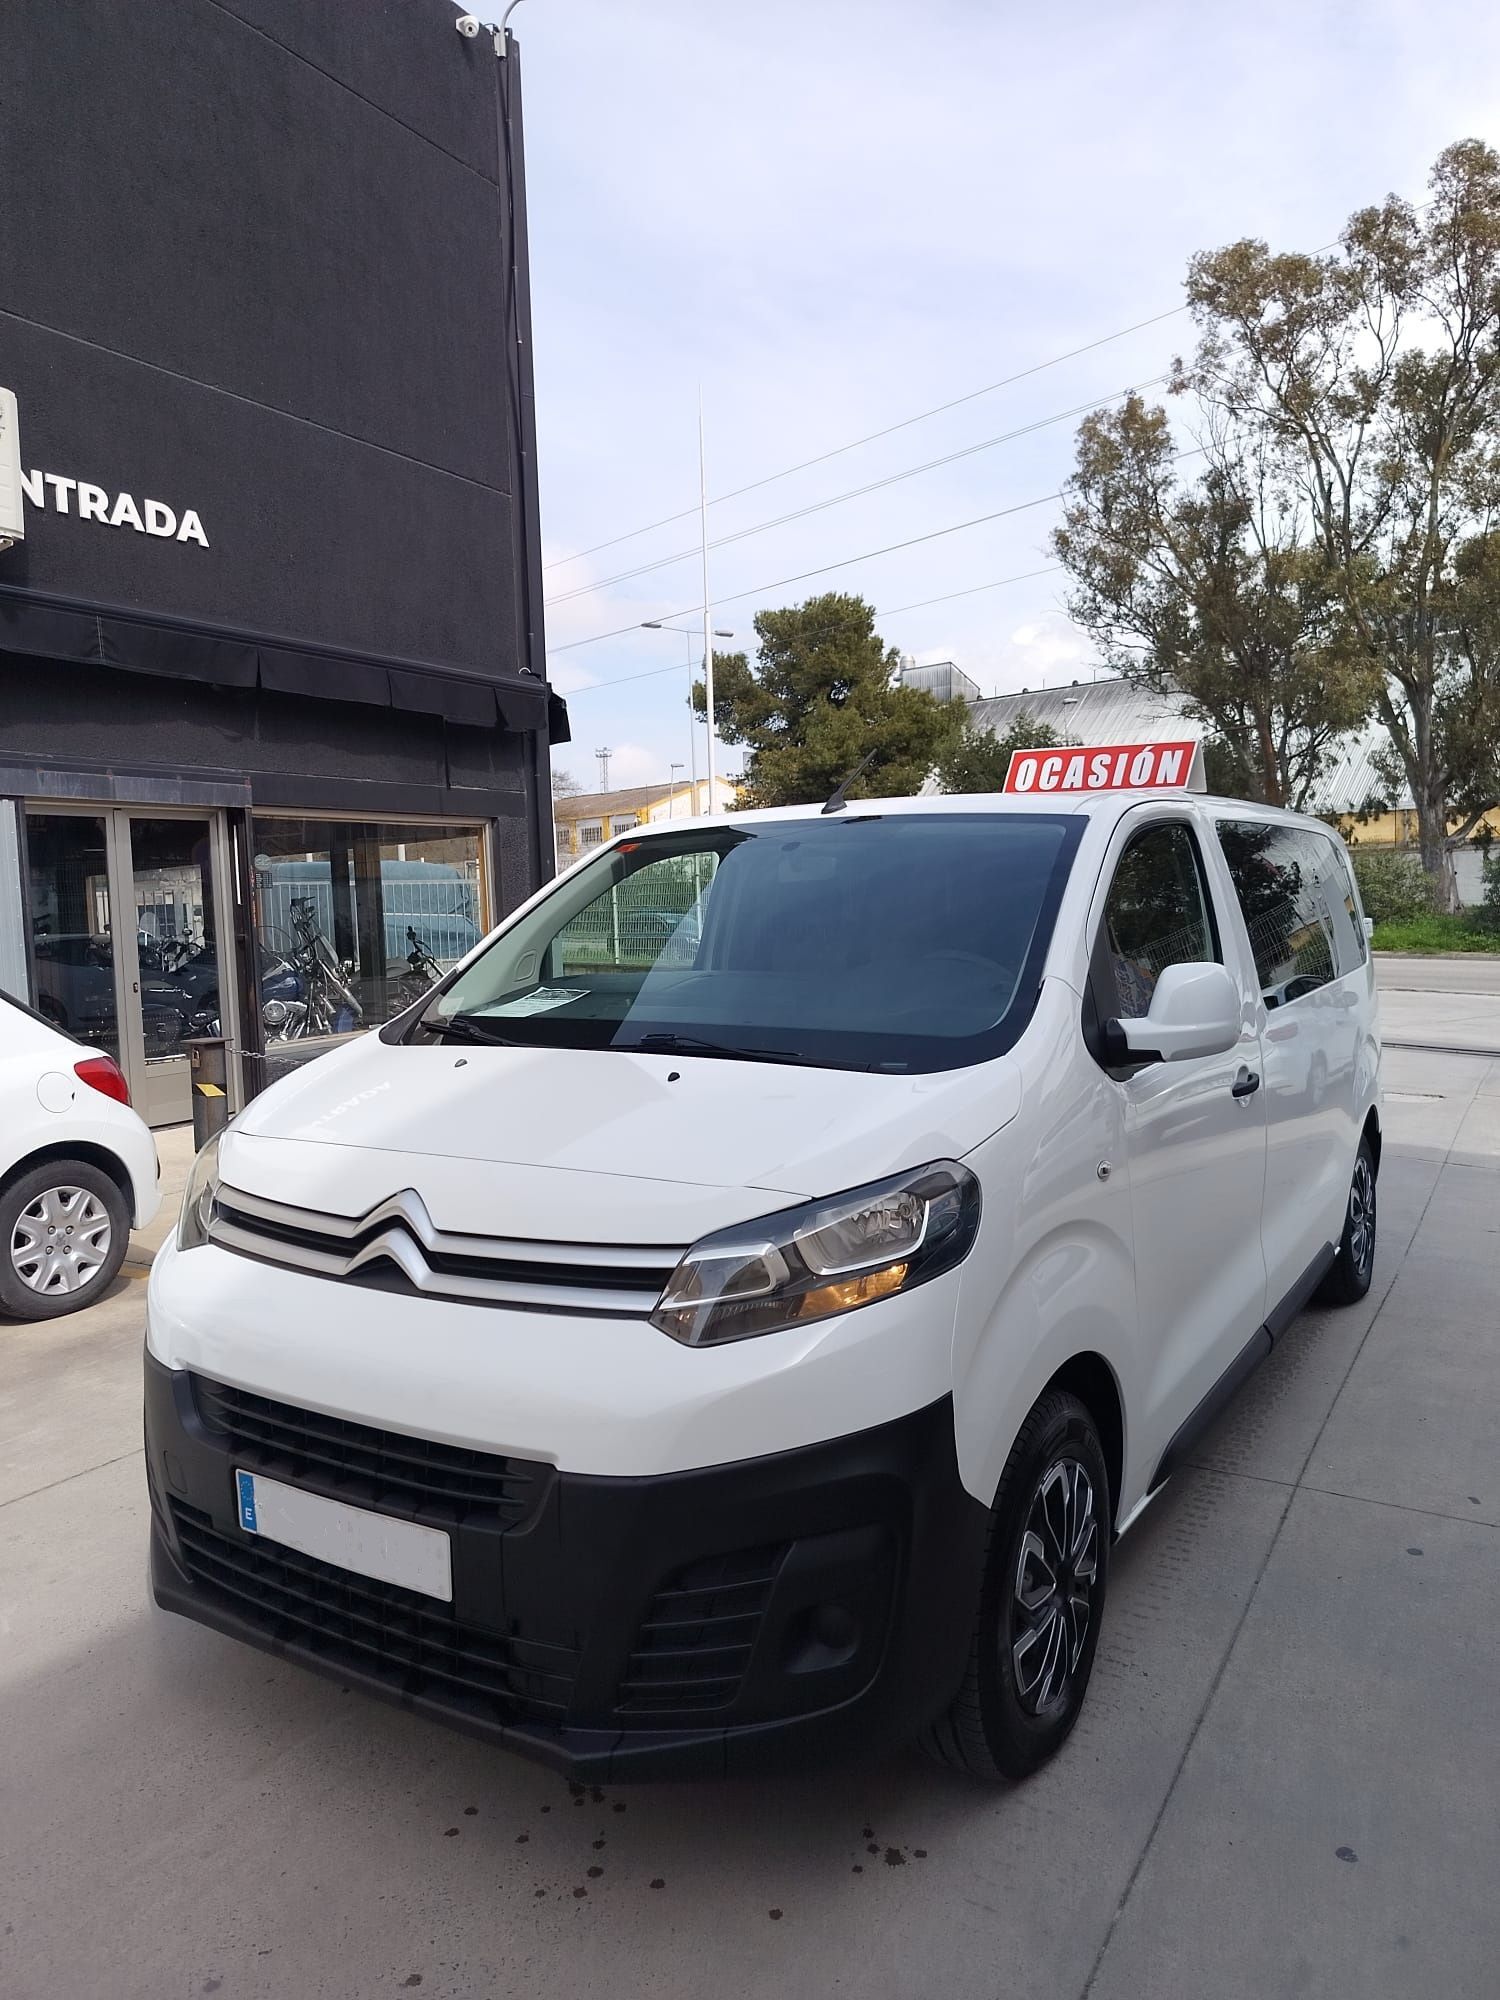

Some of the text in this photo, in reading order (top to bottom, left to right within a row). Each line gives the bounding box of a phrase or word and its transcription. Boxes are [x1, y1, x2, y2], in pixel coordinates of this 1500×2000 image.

[20, 469, 210, 548] NTRADA
[1014, 745, 1184, 792] OCASIÓN
[245, 1507, 253, 1520] E
